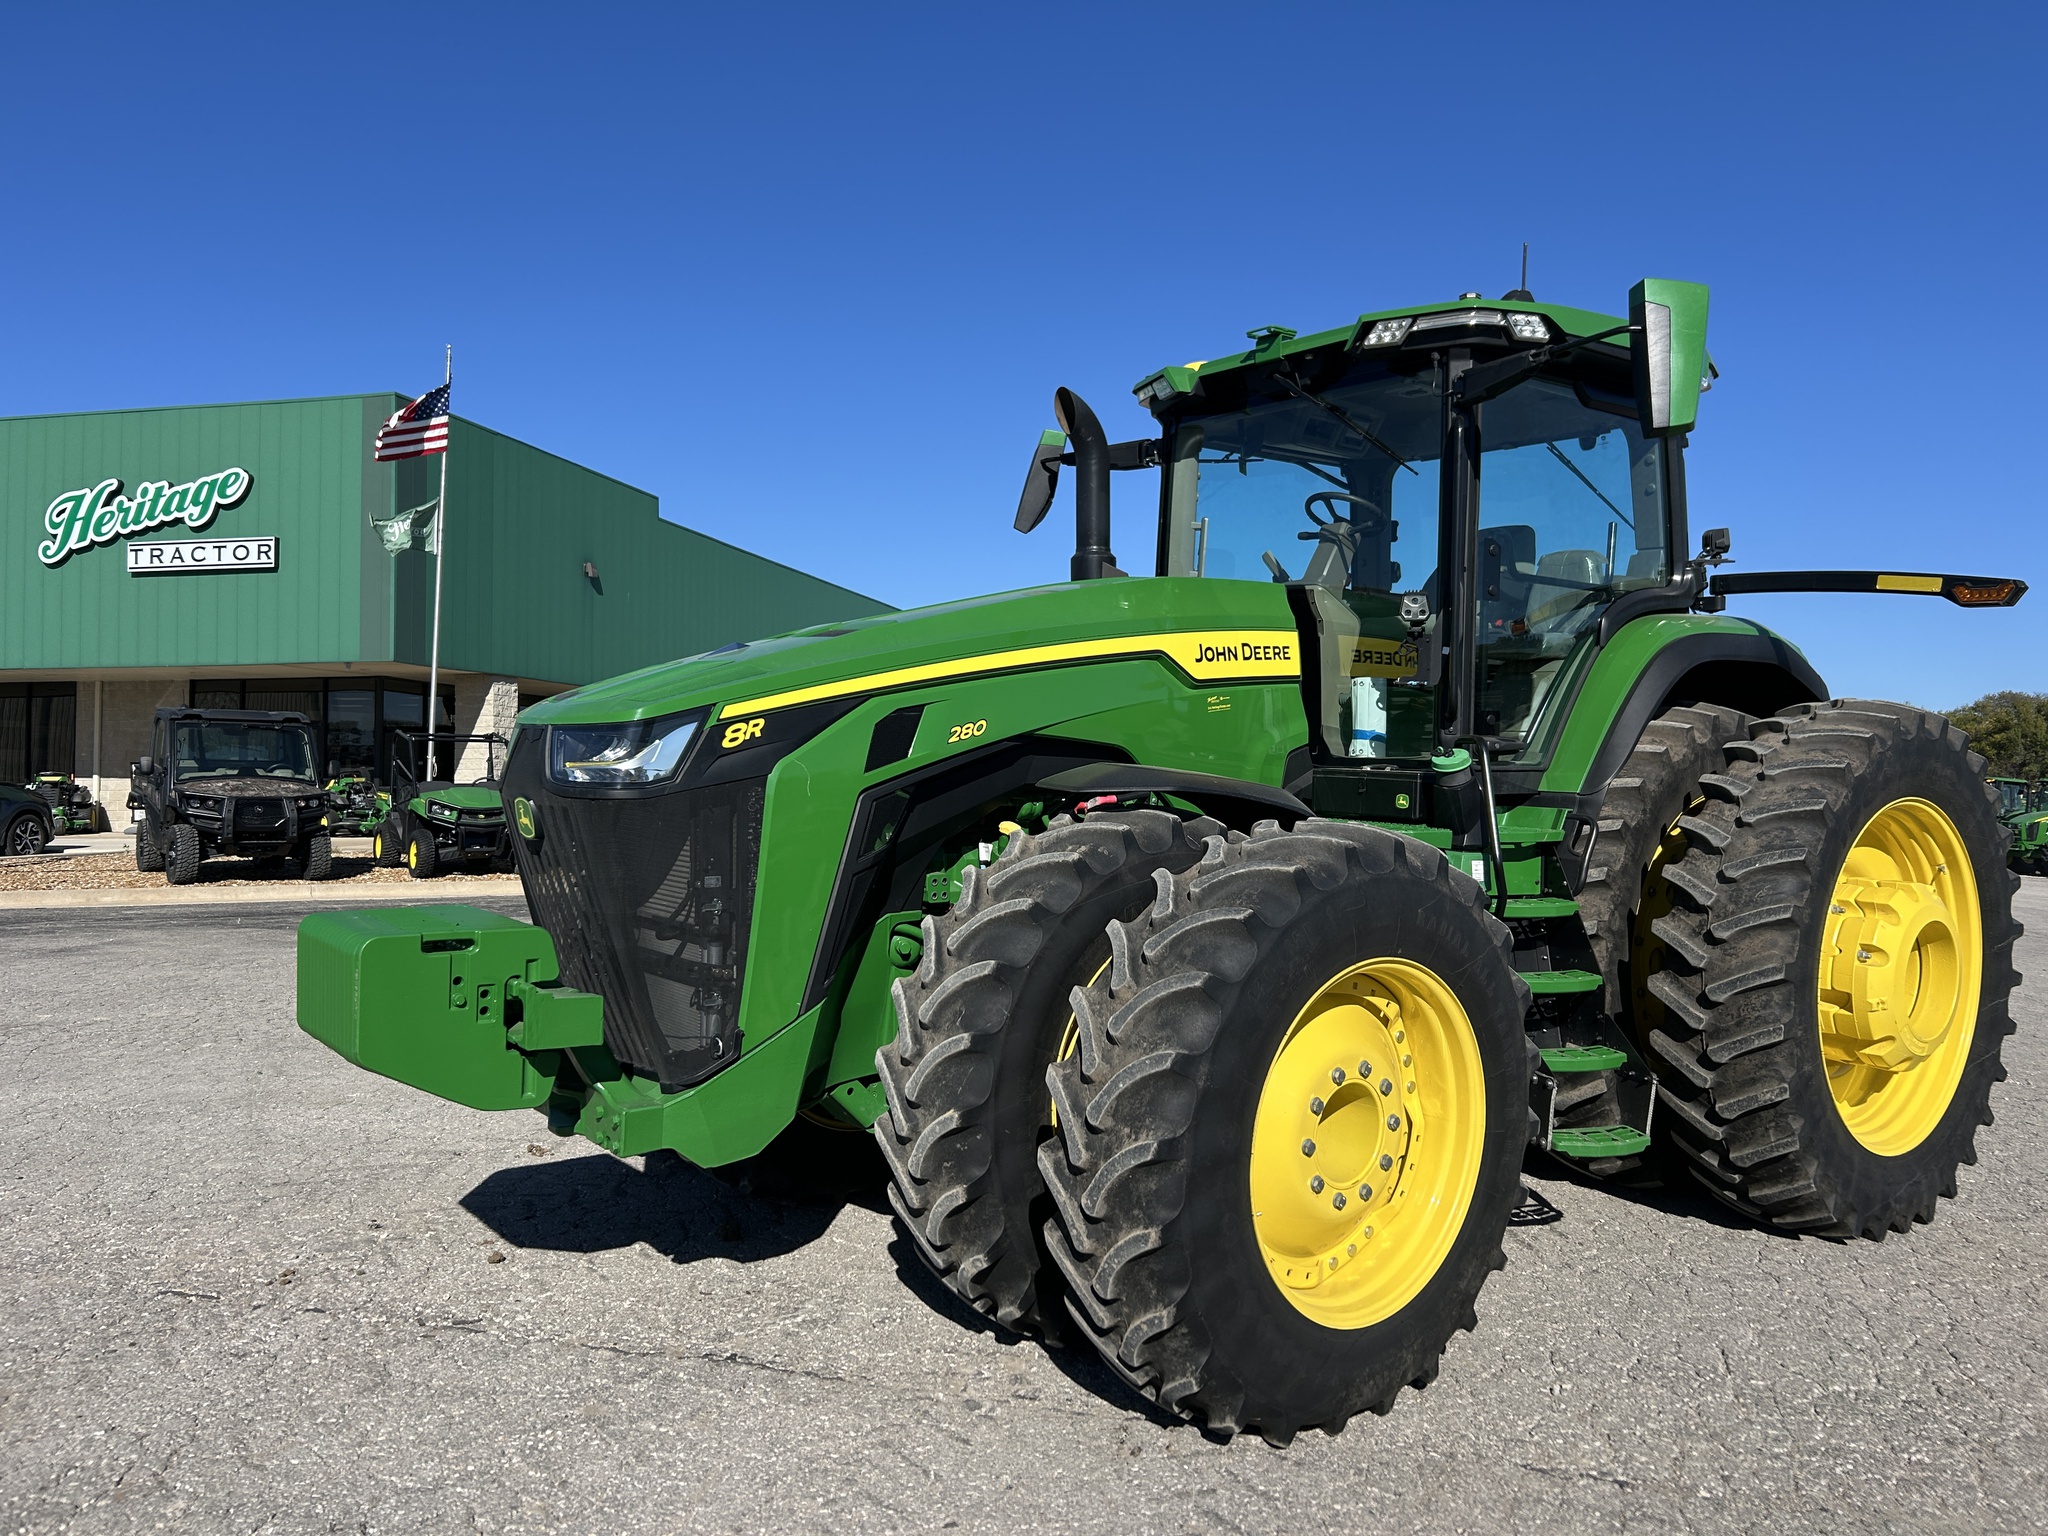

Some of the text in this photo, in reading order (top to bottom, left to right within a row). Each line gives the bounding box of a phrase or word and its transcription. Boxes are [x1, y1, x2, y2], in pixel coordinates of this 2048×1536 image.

[39, 468, 249, 563] Heritage
[129, 543, 272, 565] TRACTOR
[1195, 642, 1291, 663] JOHN DEERE
[721, 718, 766, 749] 8R
[947, 719, 988, 744] 280
